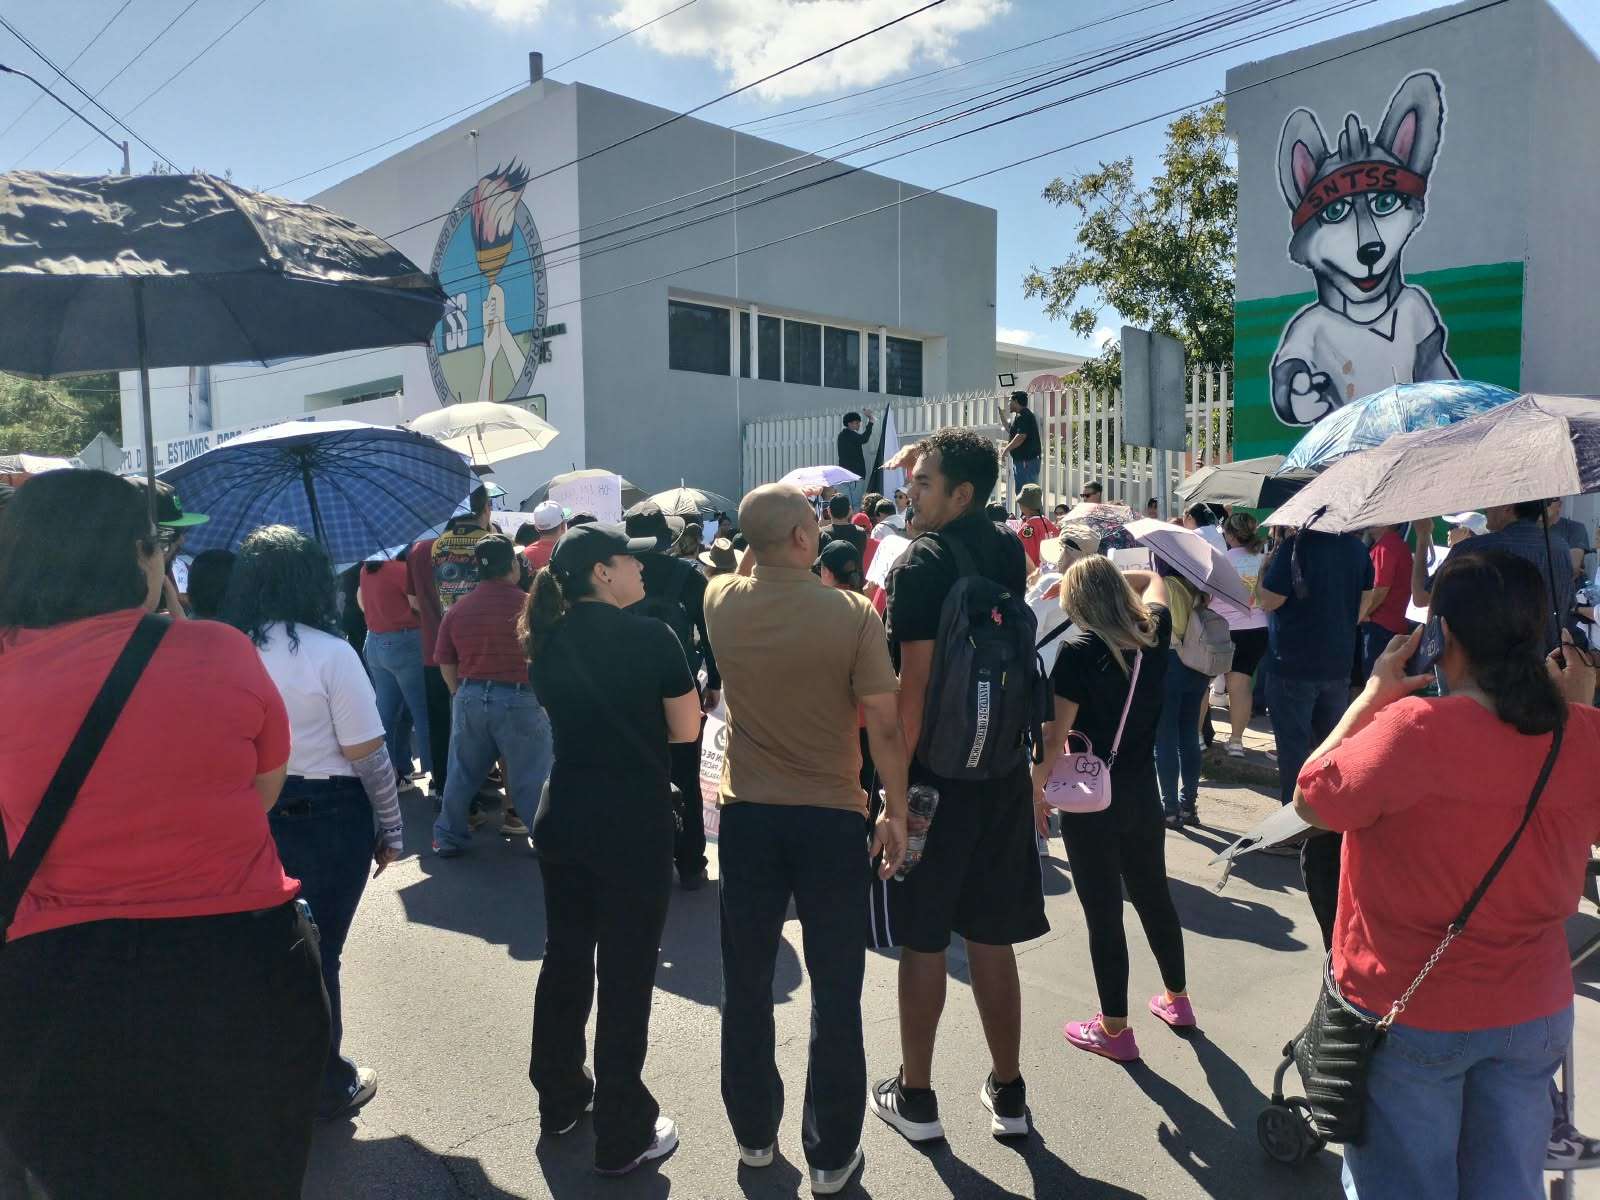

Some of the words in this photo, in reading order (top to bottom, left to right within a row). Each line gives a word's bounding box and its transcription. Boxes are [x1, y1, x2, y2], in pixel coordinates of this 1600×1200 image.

[1308, 166, 1398, 209] SNTSS
[523, 215, 545, 382] TRABAJADORES
[167, 436, 209, 464] ESTAMOS
